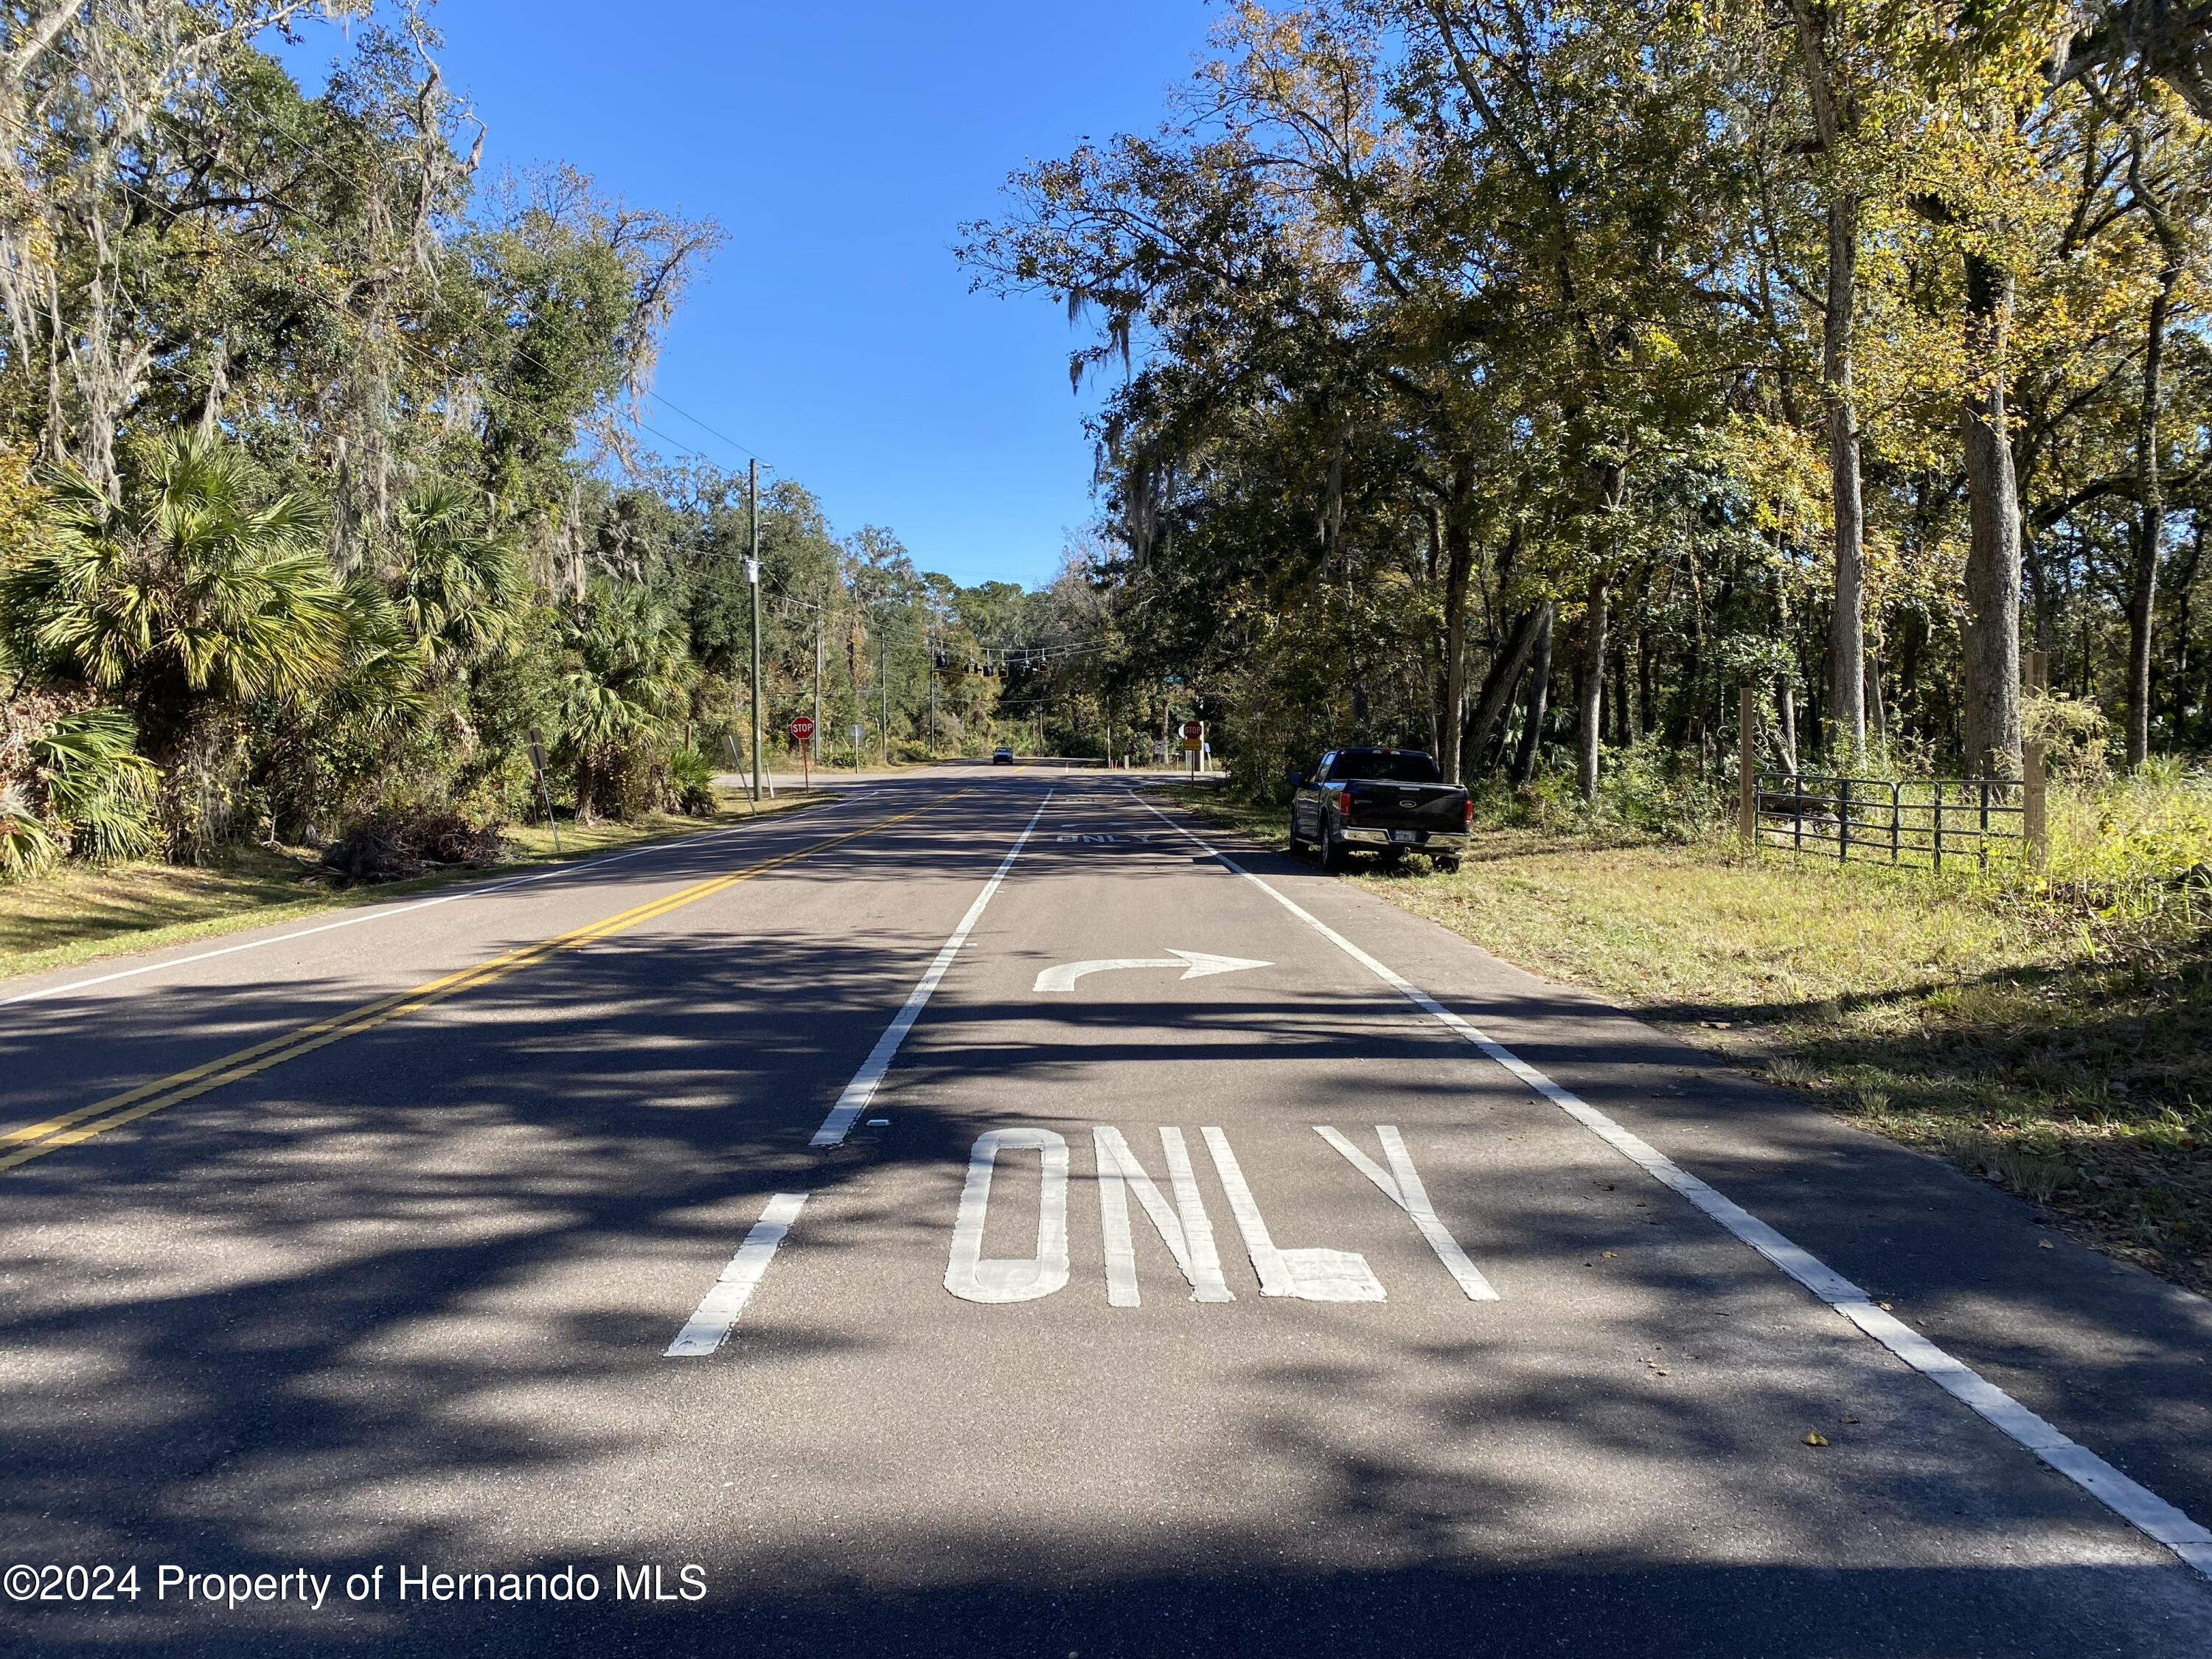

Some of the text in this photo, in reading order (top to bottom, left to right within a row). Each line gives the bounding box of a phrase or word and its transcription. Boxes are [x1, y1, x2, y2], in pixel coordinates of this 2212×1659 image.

[793, 723, 813, 732] STOP
[1056, 835, 1152, 843] ONLY
[943, 1125, 1500, 1307] ONLY
